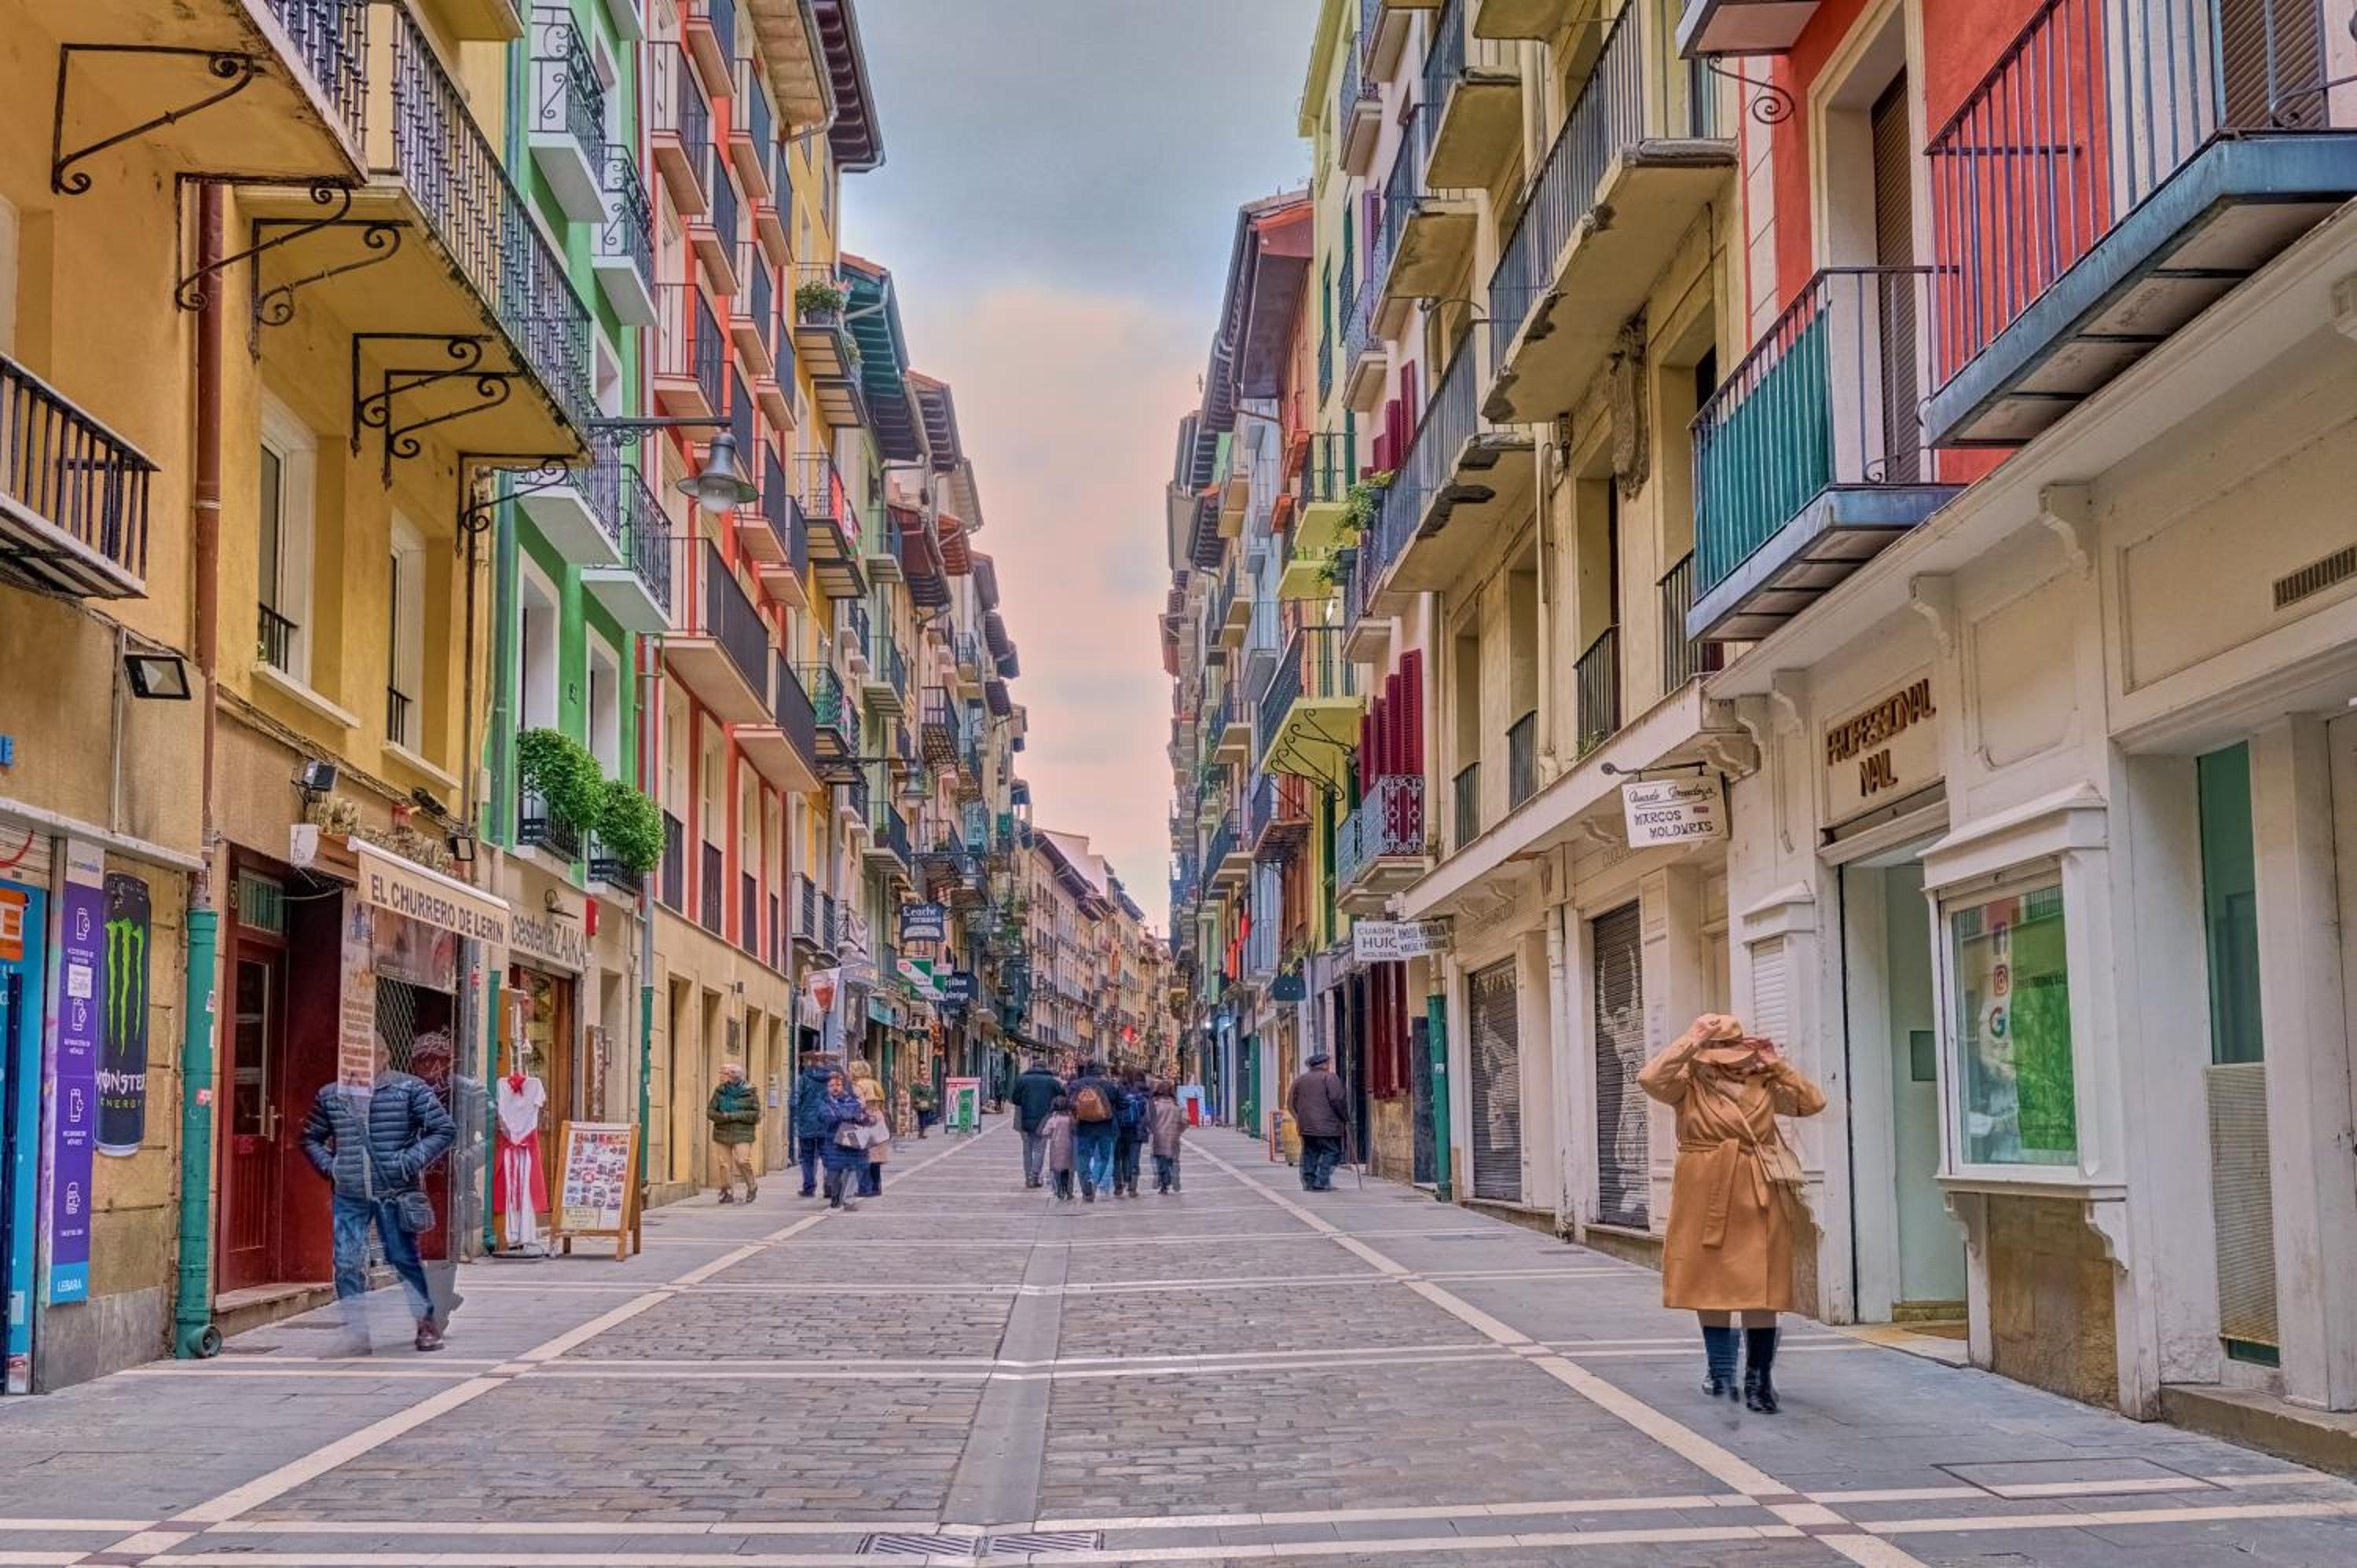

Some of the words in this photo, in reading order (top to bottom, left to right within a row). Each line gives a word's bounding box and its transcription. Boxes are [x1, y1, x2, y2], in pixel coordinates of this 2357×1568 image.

[1860, 749, 1899, 797] NAIL
[1633, 810, 1682, 826] MARCOS
[371, 874, 387, 906] EL
[390, 883, 456, 927] CHURRERO
[459, 907, 472, 934] DE
